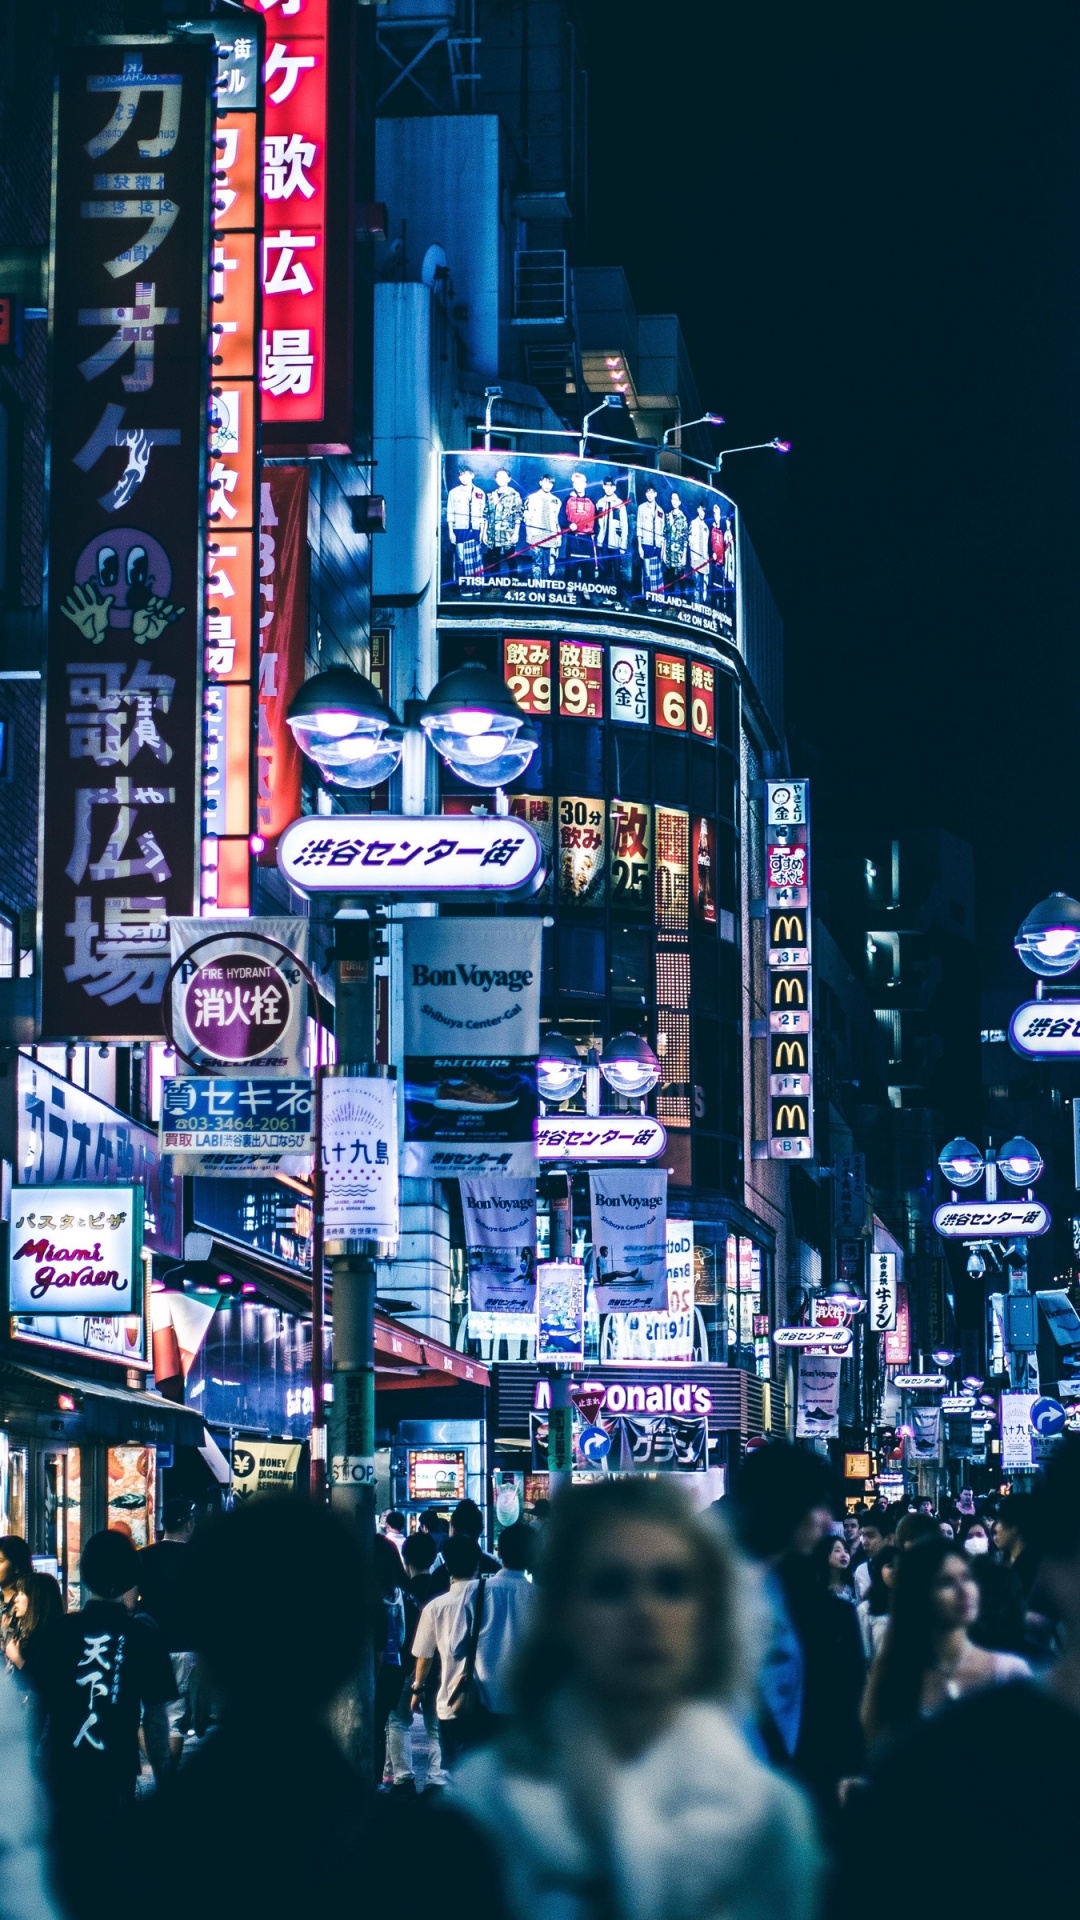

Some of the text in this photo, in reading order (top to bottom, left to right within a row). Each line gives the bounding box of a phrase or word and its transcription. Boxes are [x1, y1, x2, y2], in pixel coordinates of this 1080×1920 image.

[458, 576, 511, 587] FTISLAND
[527, 578, 566, 590] UNITED
[567, 581, 617, 596] SHADOWS
[504, 591, 577, 605] 4.12 ON SALE
[645, 591, 682, 608] FTISLAND
[691, 602, 713, 617] UNITED
[677, 611, 718, 632] 4.12 ON SALE
[615, 686, 632, 707] 金
[633, 653, 647, 720] やきとり
[560, 800, 602, 826] 30分
[774, 806, 790, 821] 金
[792, 784, 803, 823] やきとり
[560, 827, 603, 850] 飲み
[292, 838, 526, 867] 渋谷センター街
[202, 968, 223, 980] FIRE
[226, 967, 272, 979] HYDRANT
[194, 985, 283, 1028] 消火栓
[421, 1004, 464, 1030] Shibuya
[433, 1059, 512, 1068] SKECHERS
[187, 1117, 297, 1131] 03-3464-2061
[165, 1133, 193, 1147] 買取
[15, 1211, 128, 1231] パスタとピザ
[939, 1210, 1042, 1227] 渋谷センター街
[13, 1238, 104, 1263] Miami
[815, 1304, 845, 1319] 消火栓
[875, 1287, 894, 1329] 牛タン
[777, 1331, 844, 1341] 渋谷センター街
[578, 1397, 601, 1408] 止まれ
[259, 1458, 287, 1468] MONEY
